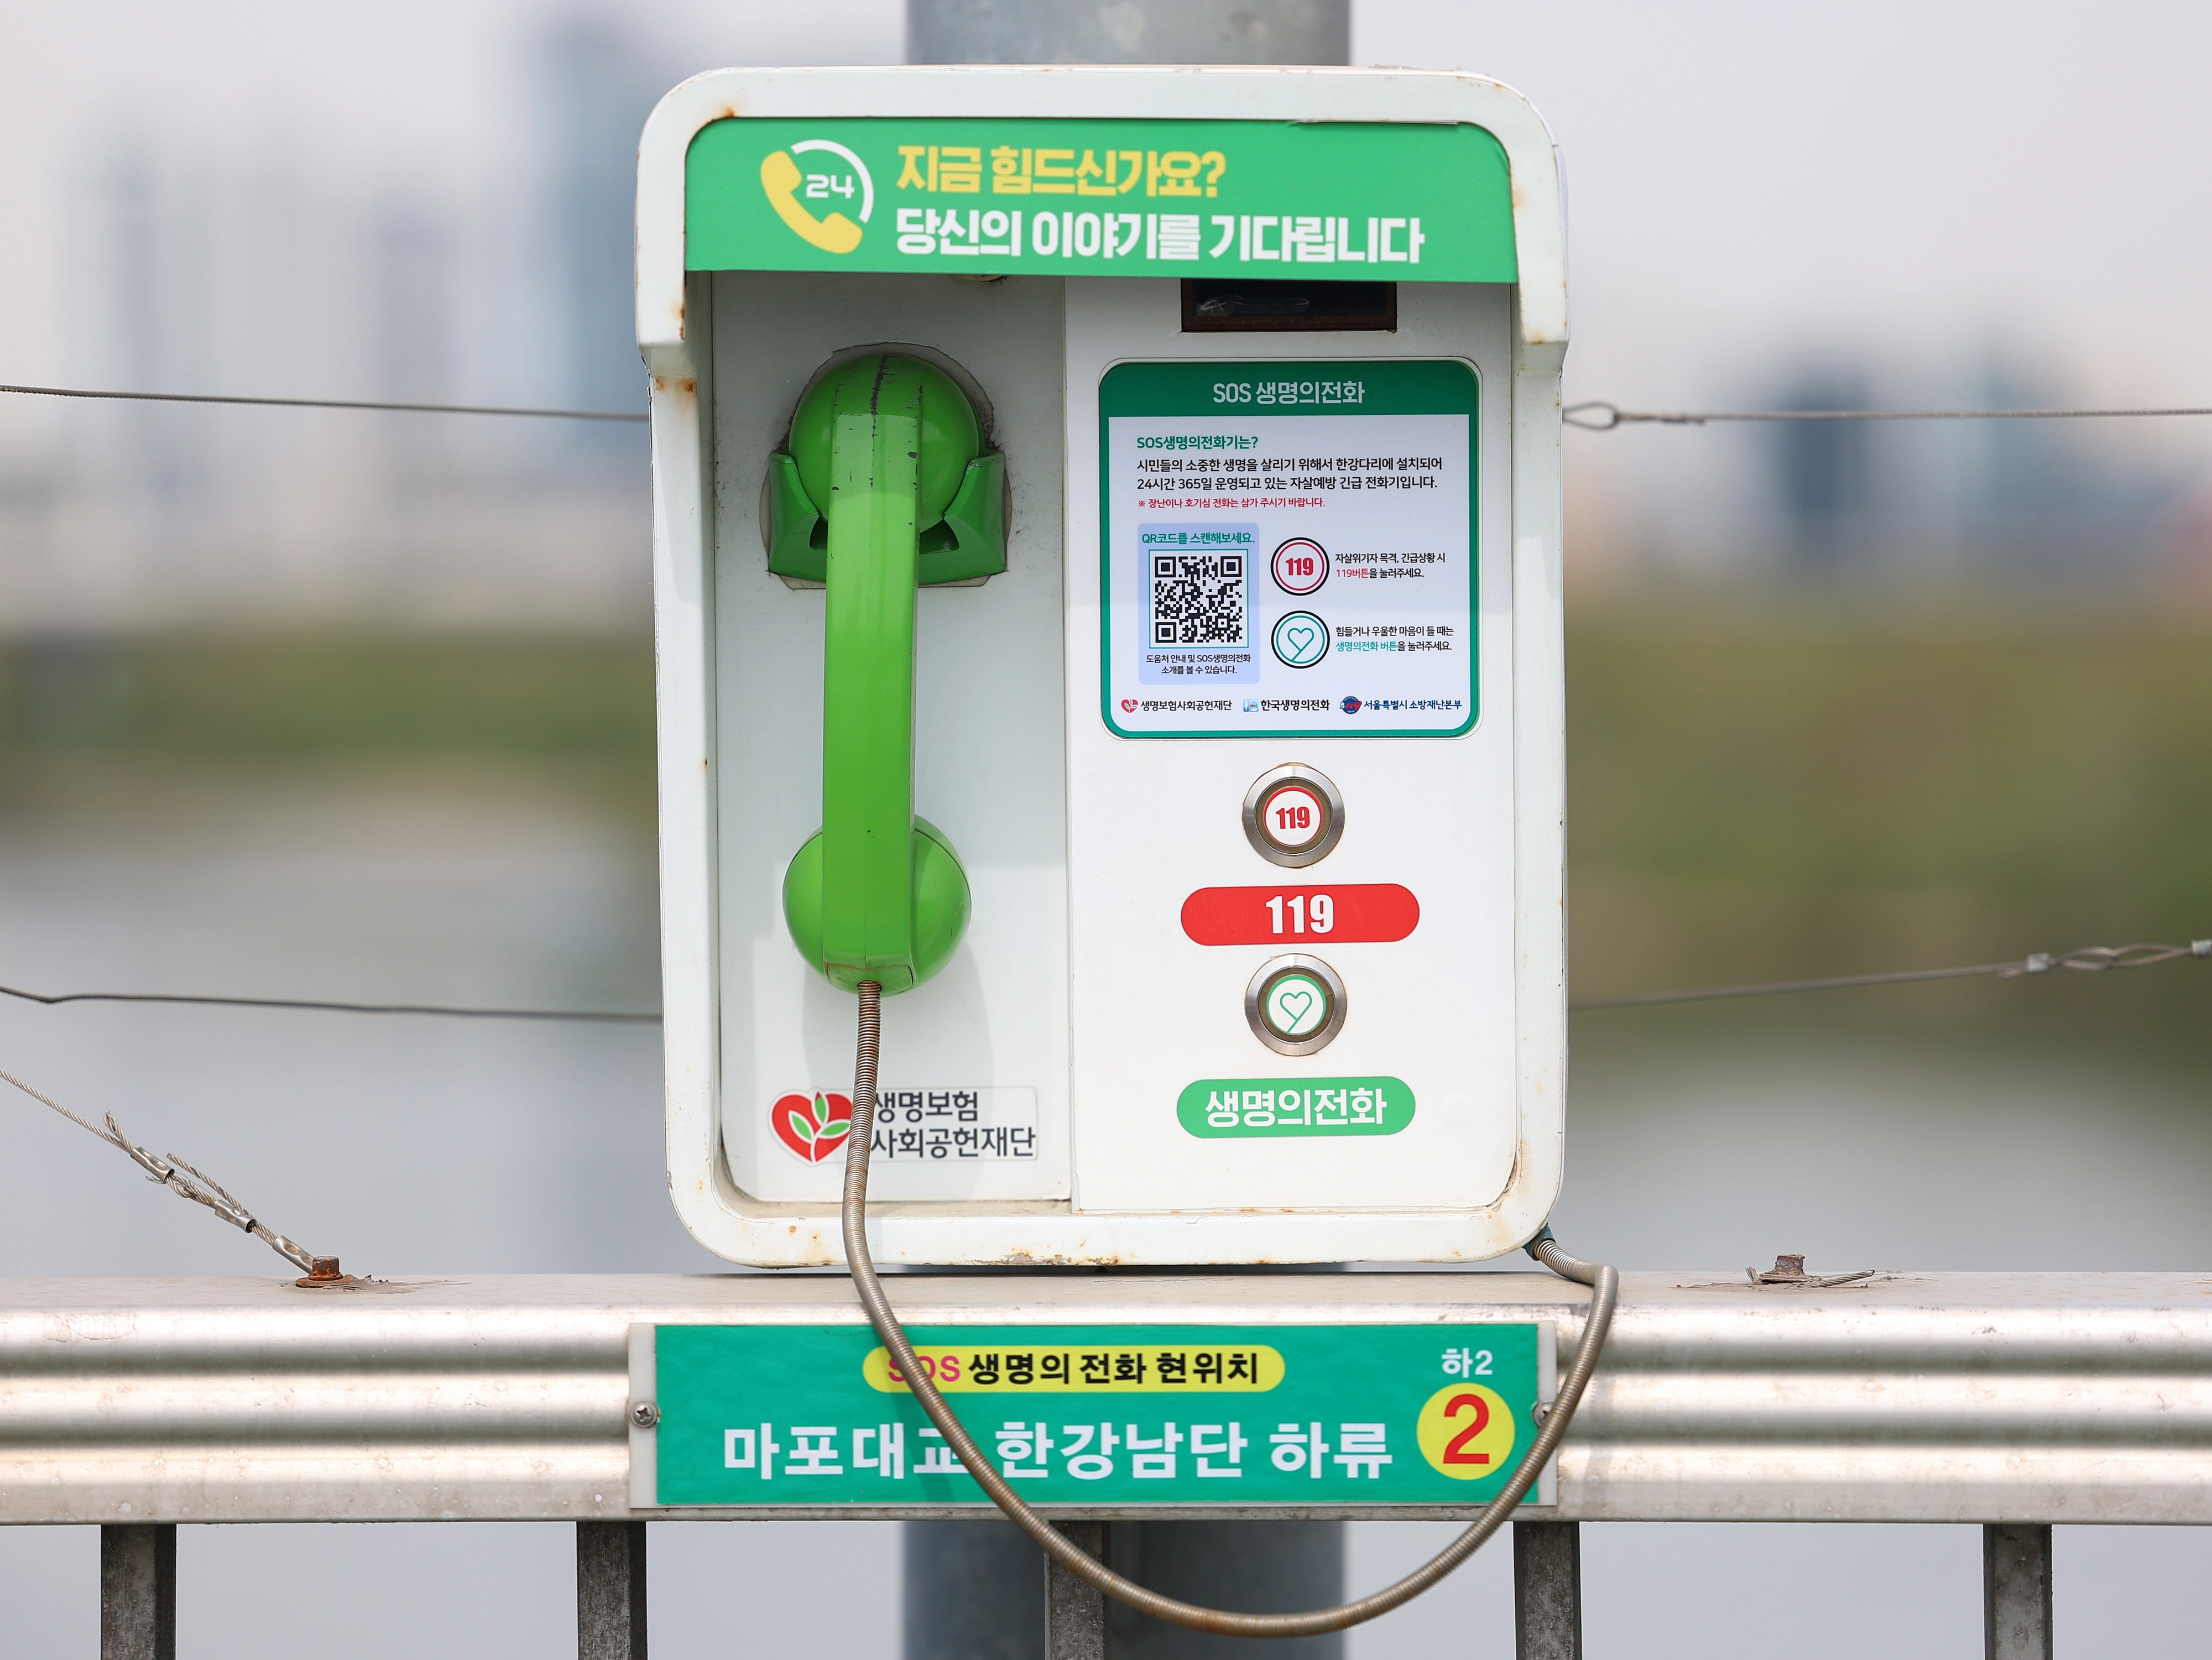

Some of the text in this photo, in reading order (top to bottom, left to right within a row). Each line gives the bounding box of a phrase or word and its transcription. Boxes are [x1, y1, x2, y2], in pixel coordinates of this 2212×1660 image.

[896, 145, 1227, 198] 지금 힘드신가요?
[806, 174, 855, 199] 24
[896, 207, 1426, 264] 당신의 이야기를 기다립니다
[1213, 380, 1365, 405] SOS 생명의전화
[1136, 435, 1258, 450] SOS생명의전화기는?
[1136, 457, 1442, 472] 시민들의 소중한 생명을 살리기 위해서 한강다리에 설치되어
[1137, 476, 1438, 490] 24시간 365일 운영되고 있는 자살예방 긴급 전화기입니다.
[1148, 498, 1183, 509] 장난이나
[1185, 498, 1211, 508] 호기심
[1212, 498, 1239, 508] 전화는
[1240, 497, 1259, 508] 삼가
[1260, 497, 1286, 508] 주시기
[1288, 497, 1325, 508] 바랍니다.
[1141, 532, 1255, 545] QR코드를 스캔해보세요.
[1285, 557, 1314, 576] 119
[1335, 552, 1445, 564] 자살위기자 목격, 긴급상황 시
[1335, 567, 1425, 578] 119버튼을 눌러주세요.
[1335, 625, 1454, 637] 힘들거나 우울한 마음이 들 때는
[1335, 640, 1452, 652] 생명의전화 버튼을 눌러주세요.
[1146, 654, 1251, 664] 도움처 안내 및 SOS생명의전화
[1161, 665, 1237, 675] 소개를 볼 수 있습니다.
[1140, 700, 1233, 712] 생명보험사회공헌재단
[1260, 699, 1331, 711] 한국생명의전화
[1364, 700, 1462, 711] 서울특별시 소방재난본부
[1275, 806, 1311, 829] 119
[1265, 894, 1334, 934] 119
[875, 1090, 978, 1124] 생명보험
[1205, 1087, 1387, 1127] 생명의전화
[870, 1126, 1036, 1159] 사회공헌재단
[968, 1353, 1070, 1385] 생명의
[1079, 1353, 1147, 1384] 전화
[1156, 1353, 1257, 1384] 현위치
[1441, 1347, 1493, 1379] 하2
[1442, 1393, 1491, 1465] 2
[995, 1421, 1249, 1480] 한강남단
[1269, 1421, 1393, 1479] 하류
